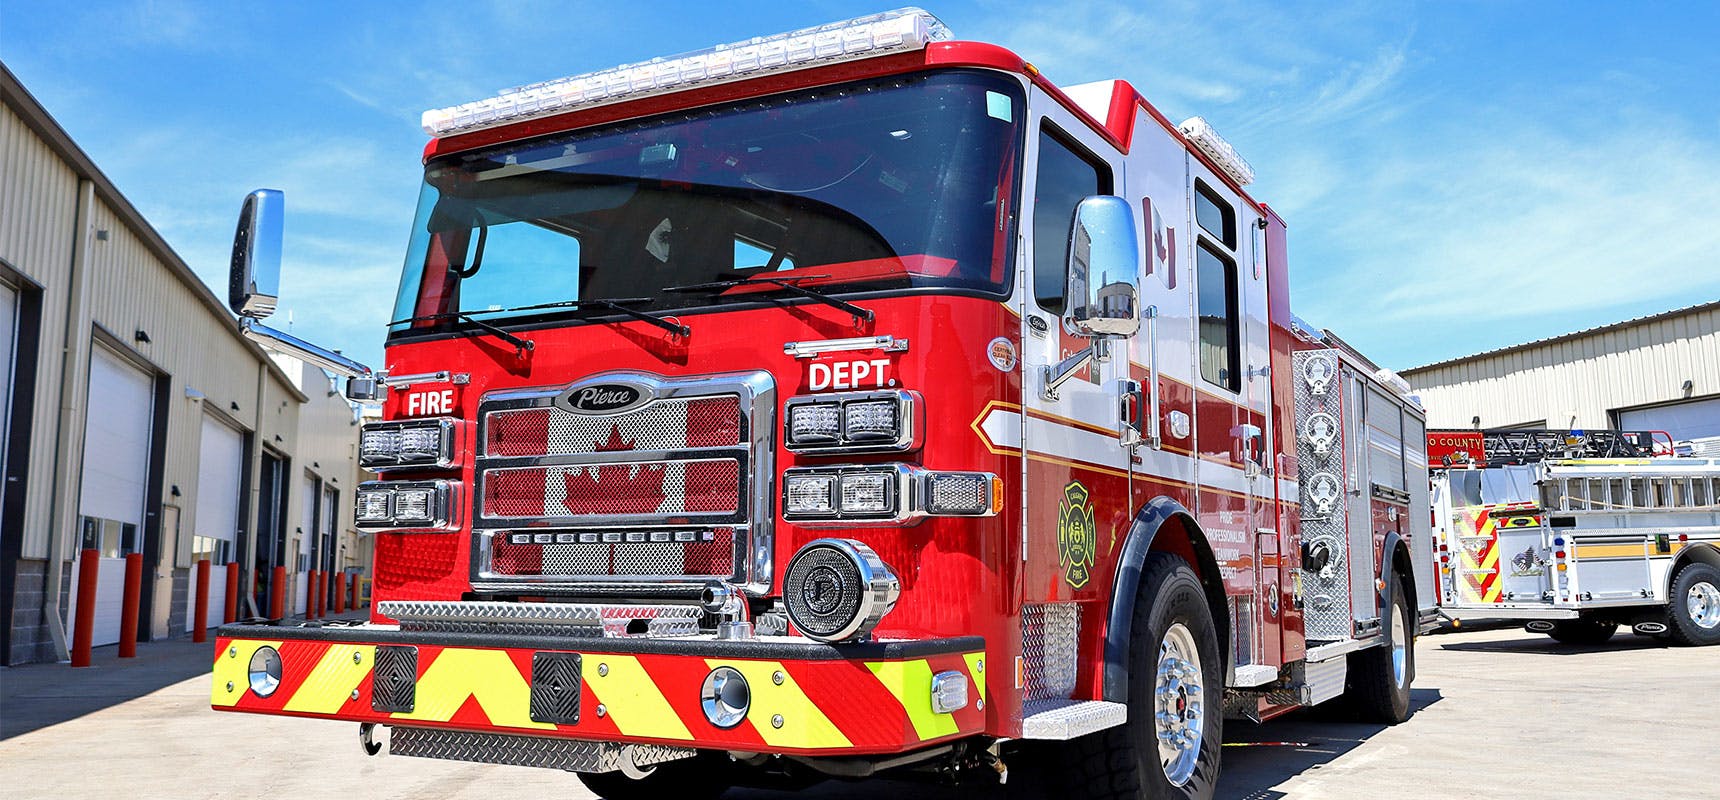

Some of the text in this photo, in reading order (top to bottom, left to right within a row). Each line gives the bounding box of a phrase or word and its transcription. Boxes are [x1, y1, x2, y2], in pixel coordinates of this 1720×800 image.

[809, 359, 896, 391] DEPT.
[408, 390, 453, 416] FIRE
[577, 387, 631, 408] Pierce
[1439, 438, 1481, 450] COUNTY
[1219, 511, 1233, 525] PRIDE
[1206, 527, 1246, 543] PROFESSIONALISM
[1215, 547, 1240, 561] TEAMWORK
[1072, 569, 1083, 580] FIRE
